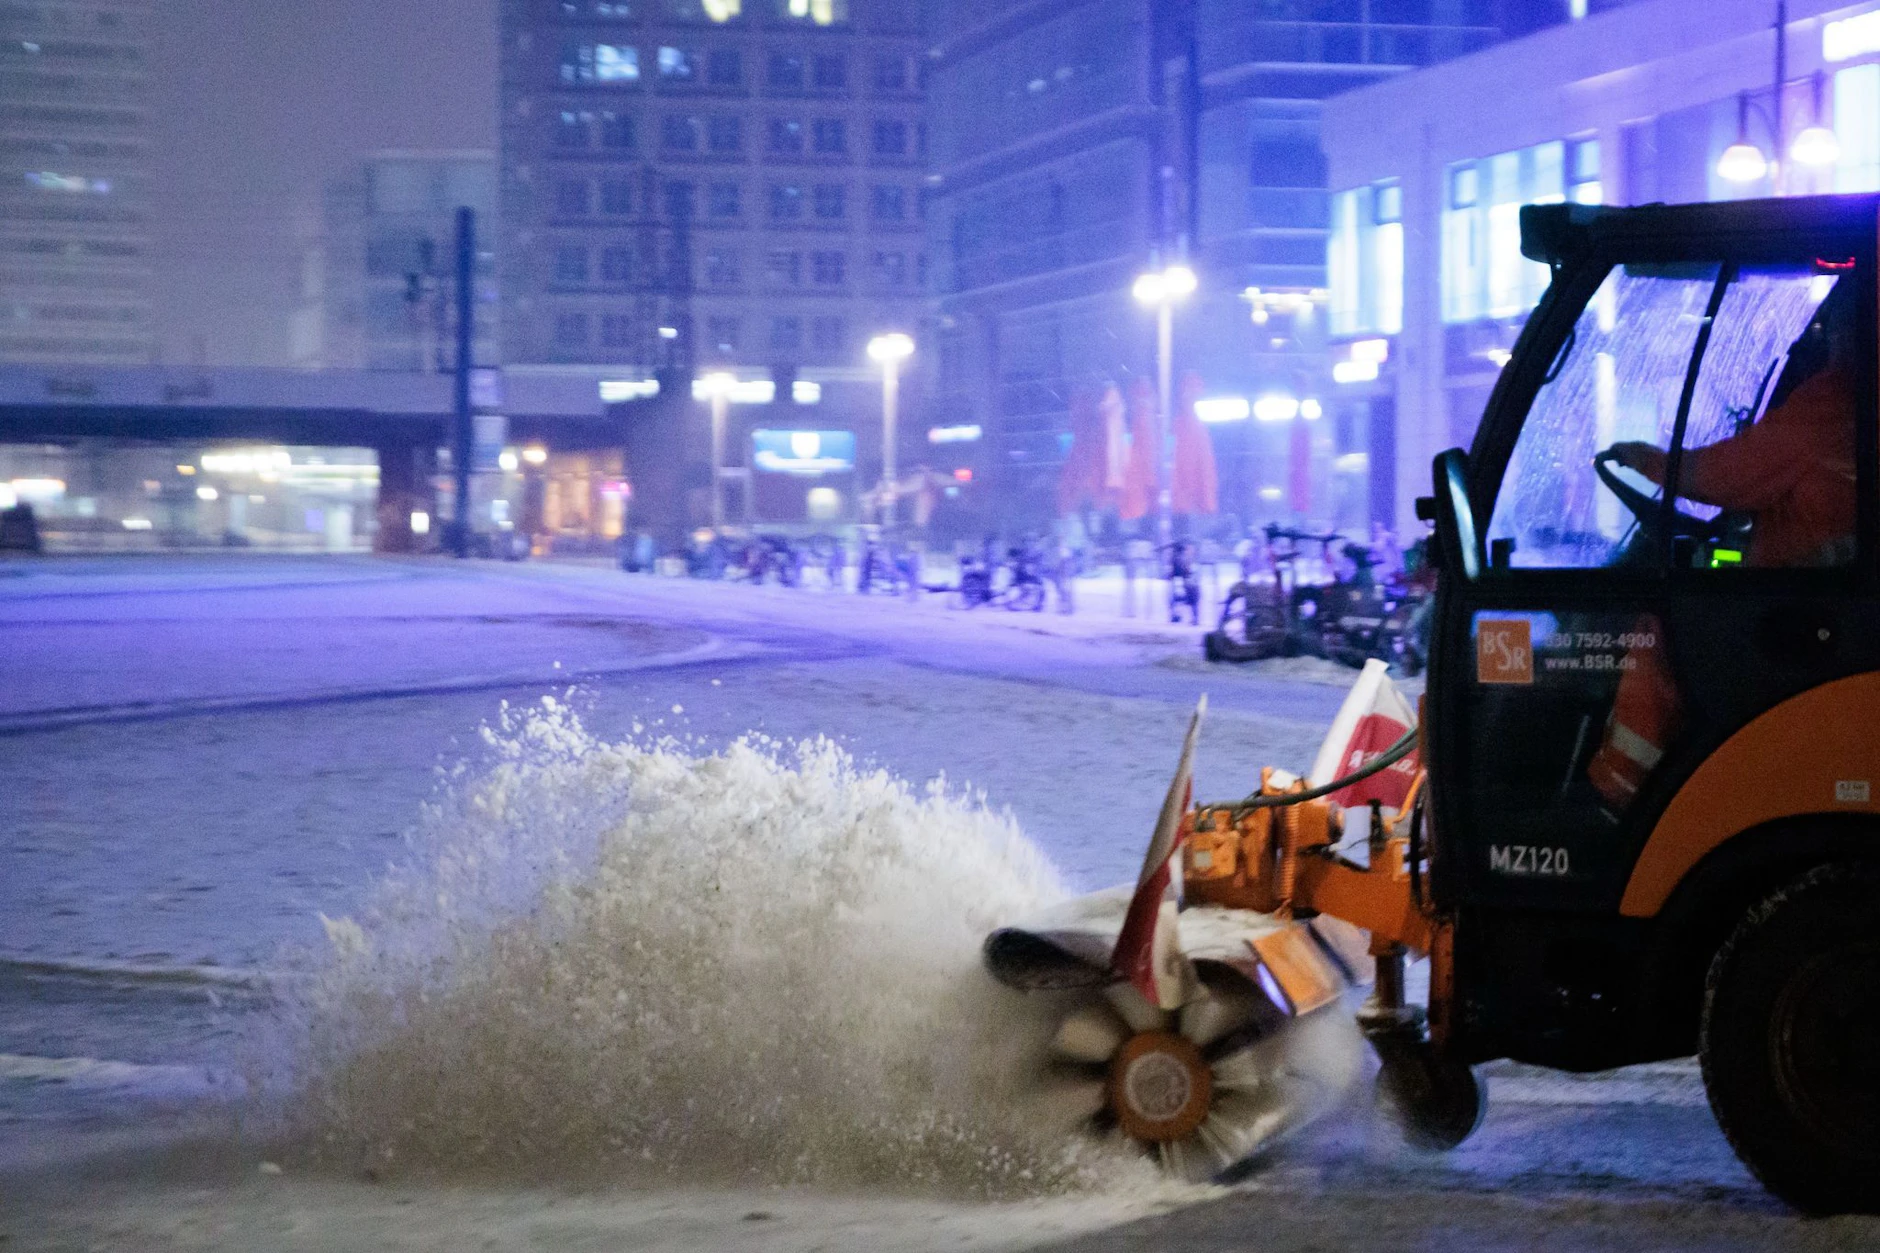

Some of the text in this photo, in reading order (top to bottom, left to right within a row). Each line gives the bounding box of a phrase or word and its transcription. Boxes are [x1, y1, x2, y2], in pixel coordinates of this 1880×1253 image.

[1482, 631, 1527, 671] BSR
[1575, 632, 1656, 649] 7592-4900
[1544, 654, 1637, 670] www.BSR.de
[1489, 844, 1569, 875] MZ120
